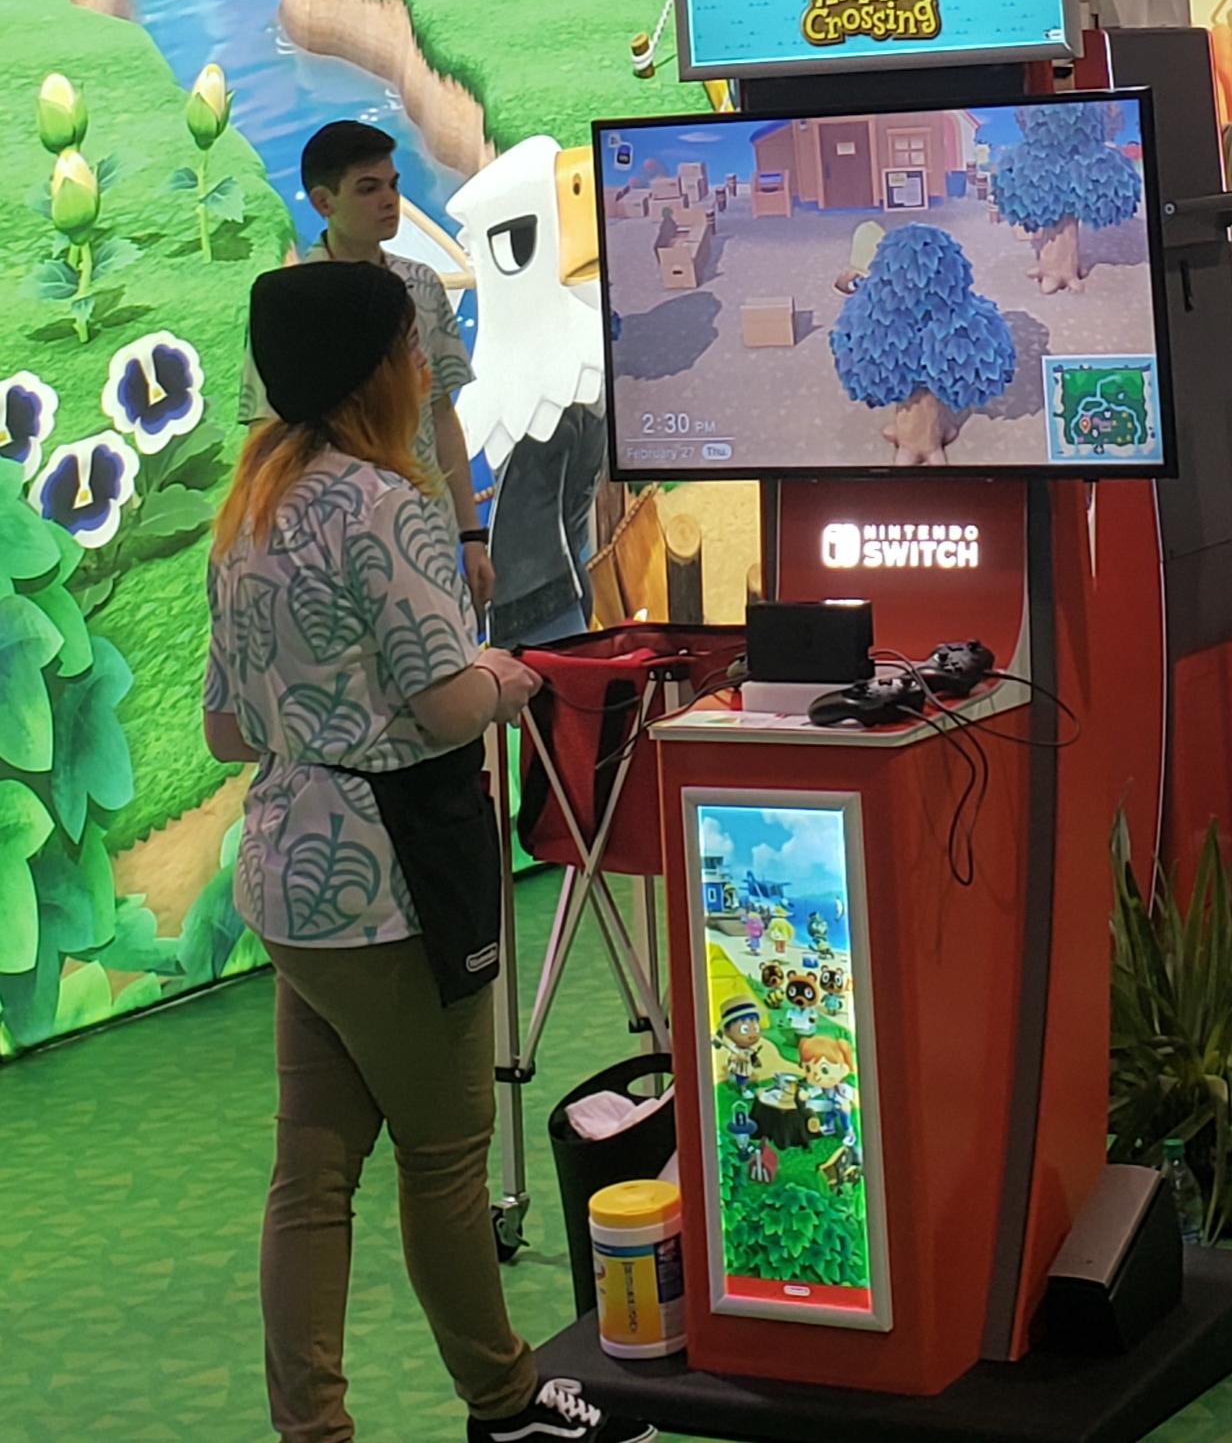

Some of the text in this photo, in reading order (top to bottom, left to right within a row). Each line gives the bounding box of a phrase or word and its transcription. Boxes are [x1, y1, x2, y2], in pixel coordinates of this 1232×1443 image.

[642, 412, 716, 434] 2:30 PM
[626, 446, 677, 461] February
[681, 446, 695, 458] 27
[863, 523, 979, 541] NINTENDO
[862, 540, 979, 569] SWITCH
